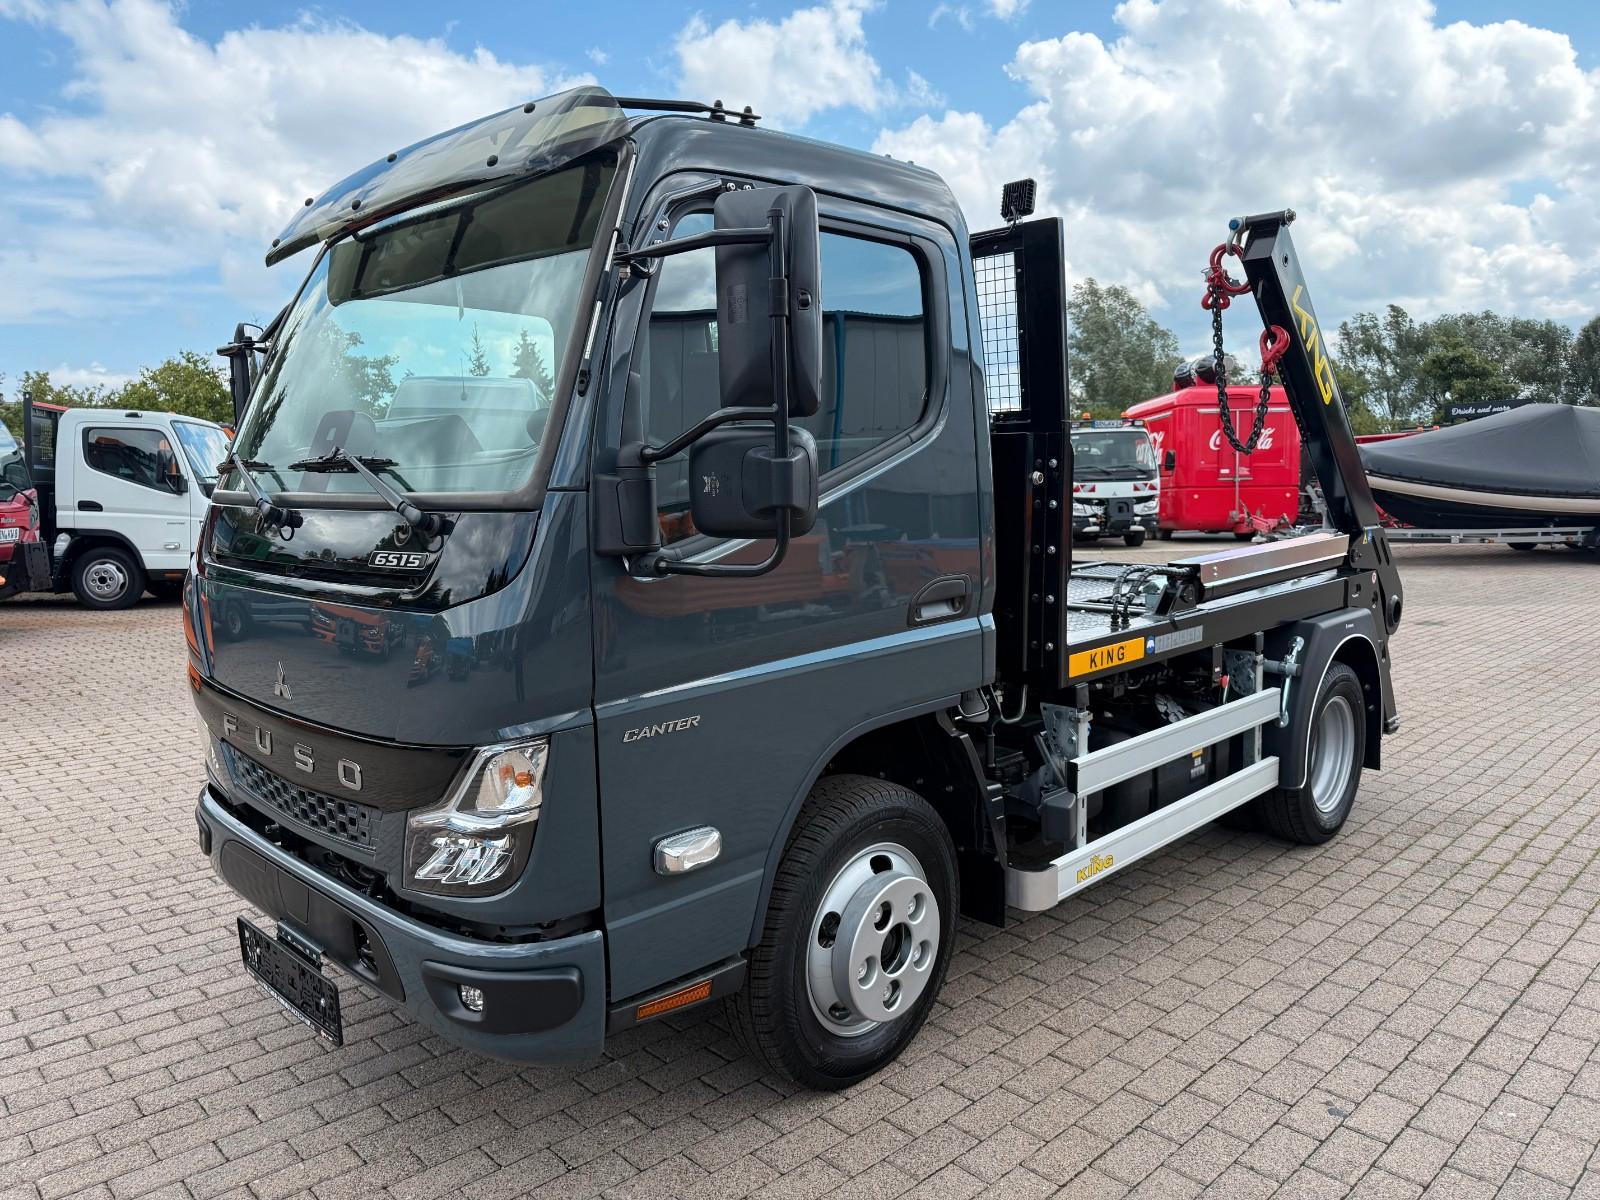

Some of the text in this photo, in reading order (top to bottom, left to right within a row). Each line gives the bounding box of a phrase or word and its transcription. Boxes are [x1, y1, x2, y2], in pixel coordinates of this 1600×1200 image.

[374, 553, 422, 567] 6S15
[1089, 645, 1127, 670] KING
[622, 714, 701, 743] CANTER
[223, 711, 363, 791] FUSO
[1076, 854, 1114, 884] KING
